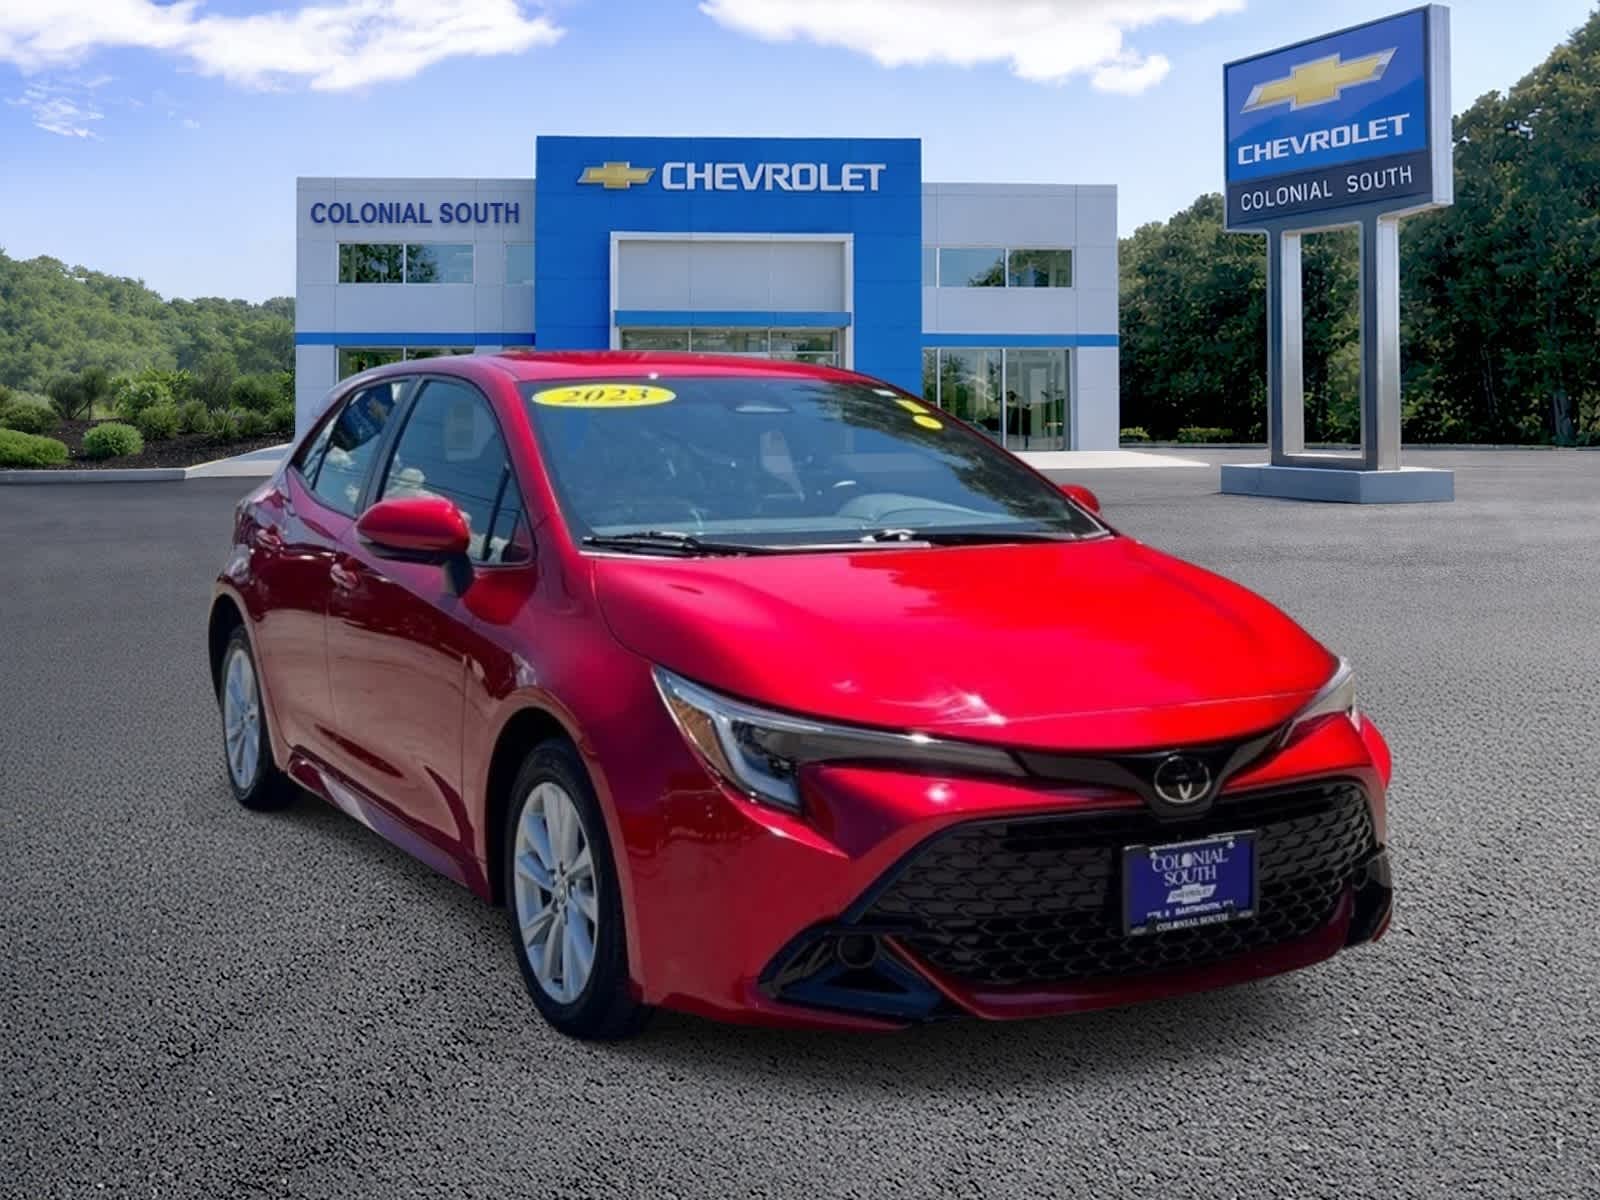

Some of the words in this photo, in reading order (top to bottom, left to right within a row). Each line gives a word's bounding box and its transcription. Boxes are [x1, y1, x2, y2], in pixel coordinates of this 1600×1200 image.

[1238, 113, 1410, 165] CHEVROLET
[662, 162, 887, 192] CHEVROLET
[1241, 180, 1333, 211] COLONIAL
[1346, 165, 1412, 193] SOUTH
[310, 202, 433, 224] COLONIAL
[439, 202, 520, 224] SOUTH
[562, 388, 649, 402] 2023
[1164, 865, 1217, 887] SOUTH
[1156, 918, 1200, 932] COLONIAL
[1199, 912, 1229, 925] SOUTH
